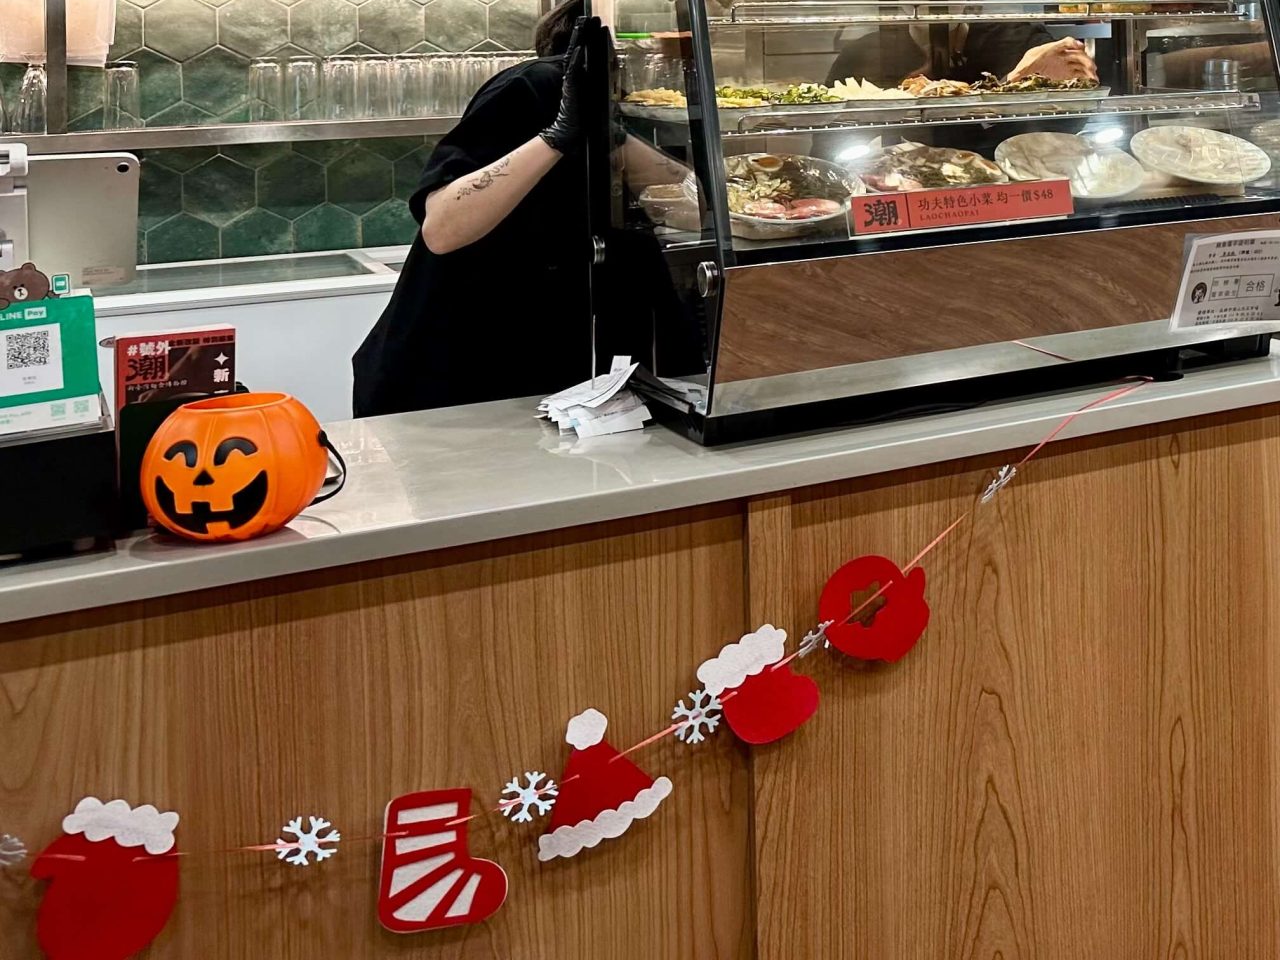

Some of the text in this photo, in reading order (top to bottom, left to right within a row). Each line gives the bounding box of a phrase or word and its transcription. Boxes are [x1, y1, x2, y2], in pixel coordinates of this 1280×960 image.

[918, 189, 1053, 211] 功夫特色小菜 均一價$48
[864, 199, 899, 228] 潮
[1246, 280, 1265, 292] 合格
[0, 309, 44, 320] LINE Pay
